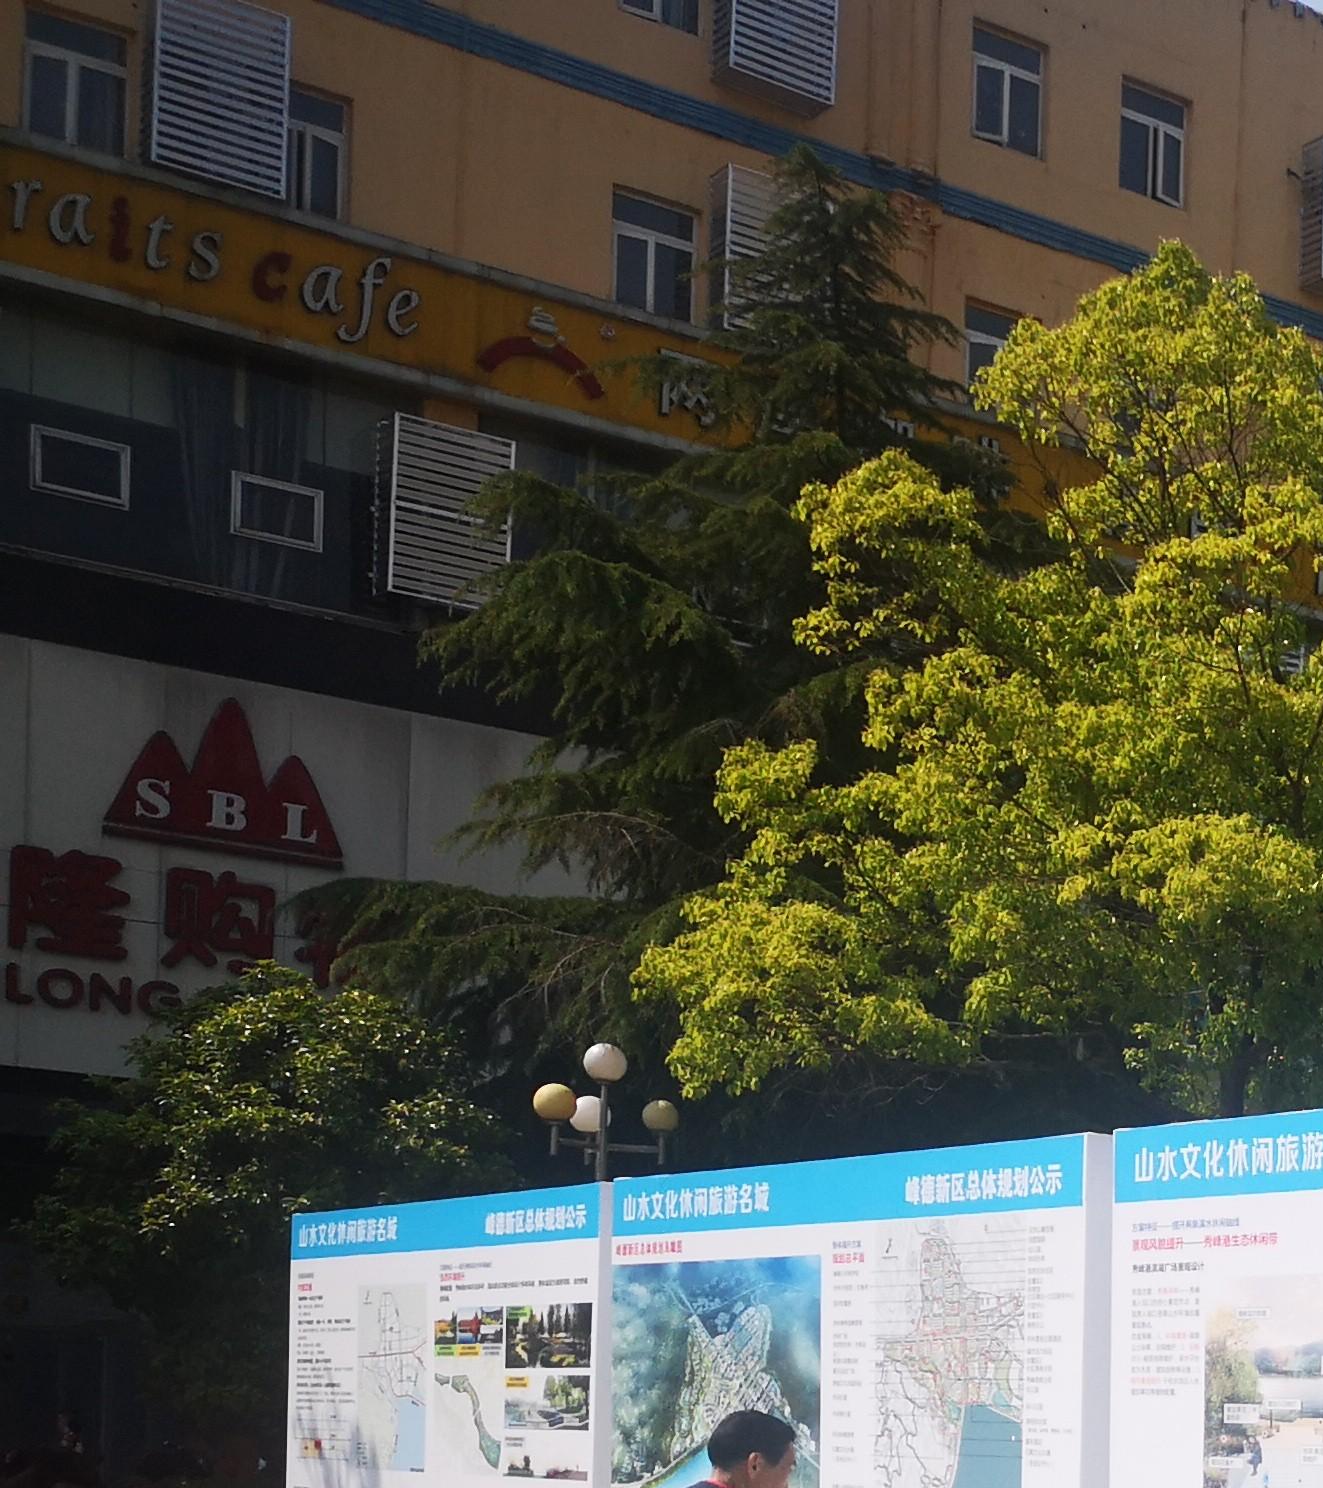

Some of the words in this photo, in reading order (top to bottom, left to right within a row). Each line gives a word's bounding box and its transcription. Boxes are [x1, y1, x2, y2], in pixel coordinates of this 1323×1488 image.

[250, 251, 424, 345] cafe
[135, 778, 317, 845] SBL
[622, 1181, 770, 1222] 山水文化休闲旅游名城
[904, 1163, 1063, 1206] 峰德新区总体规划公示
